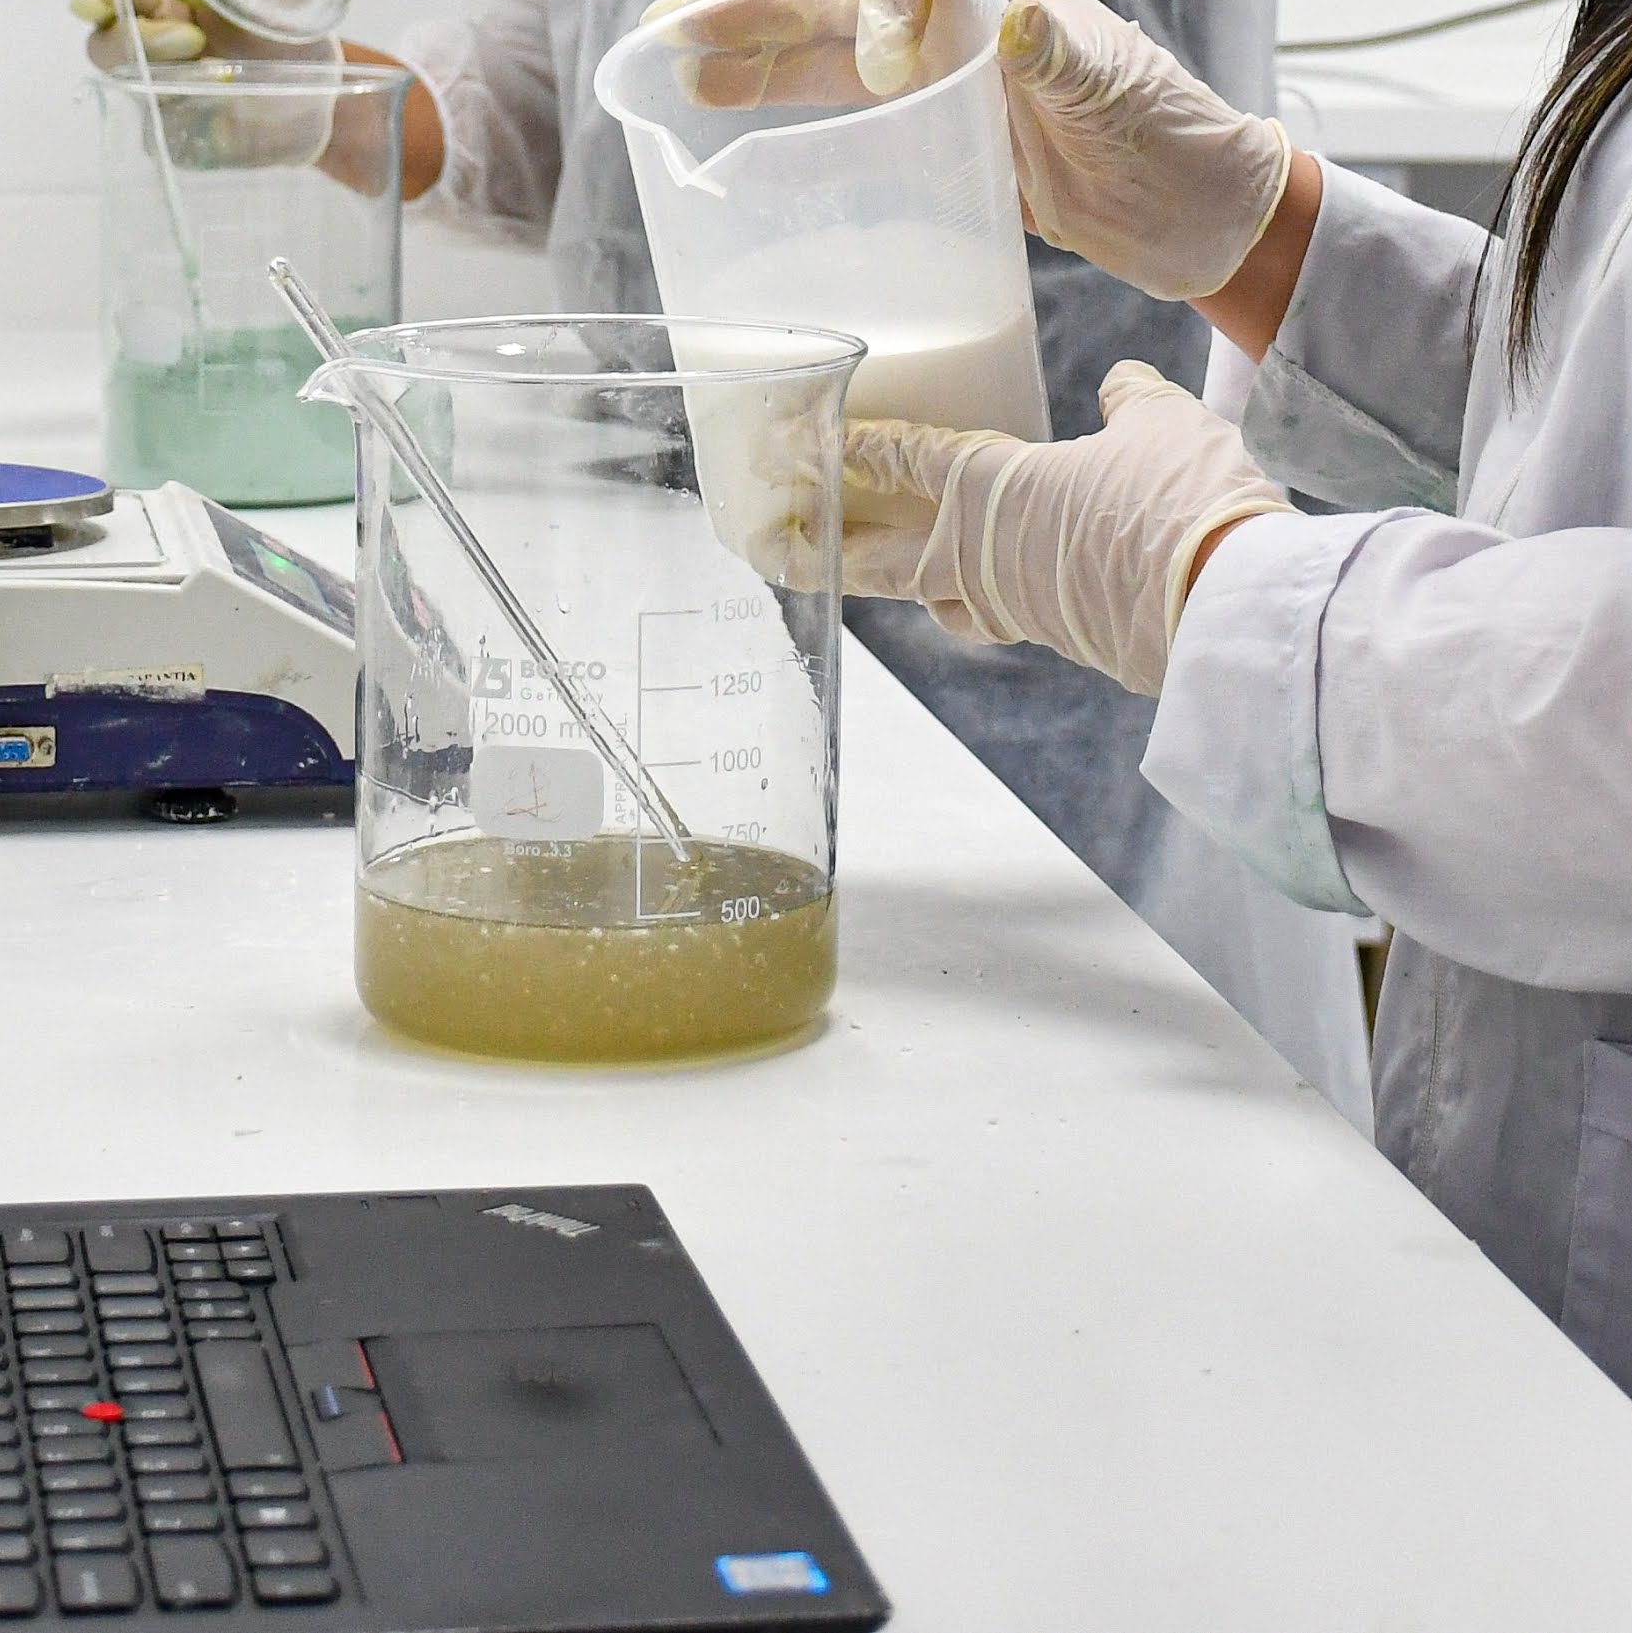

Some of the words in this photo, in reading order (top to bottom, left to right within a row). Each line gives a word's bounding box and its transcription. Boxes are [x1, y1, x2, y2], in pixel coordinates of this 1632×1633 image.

[710, 596, 762, 623] 1500
[710, 670, 762, 697] 1250
[486, 711, 548, 738] 2000
[710, 746, 762, 773] 1000
[721, 821, 761, 844] 750
[720, 895, 761, 924] 500
